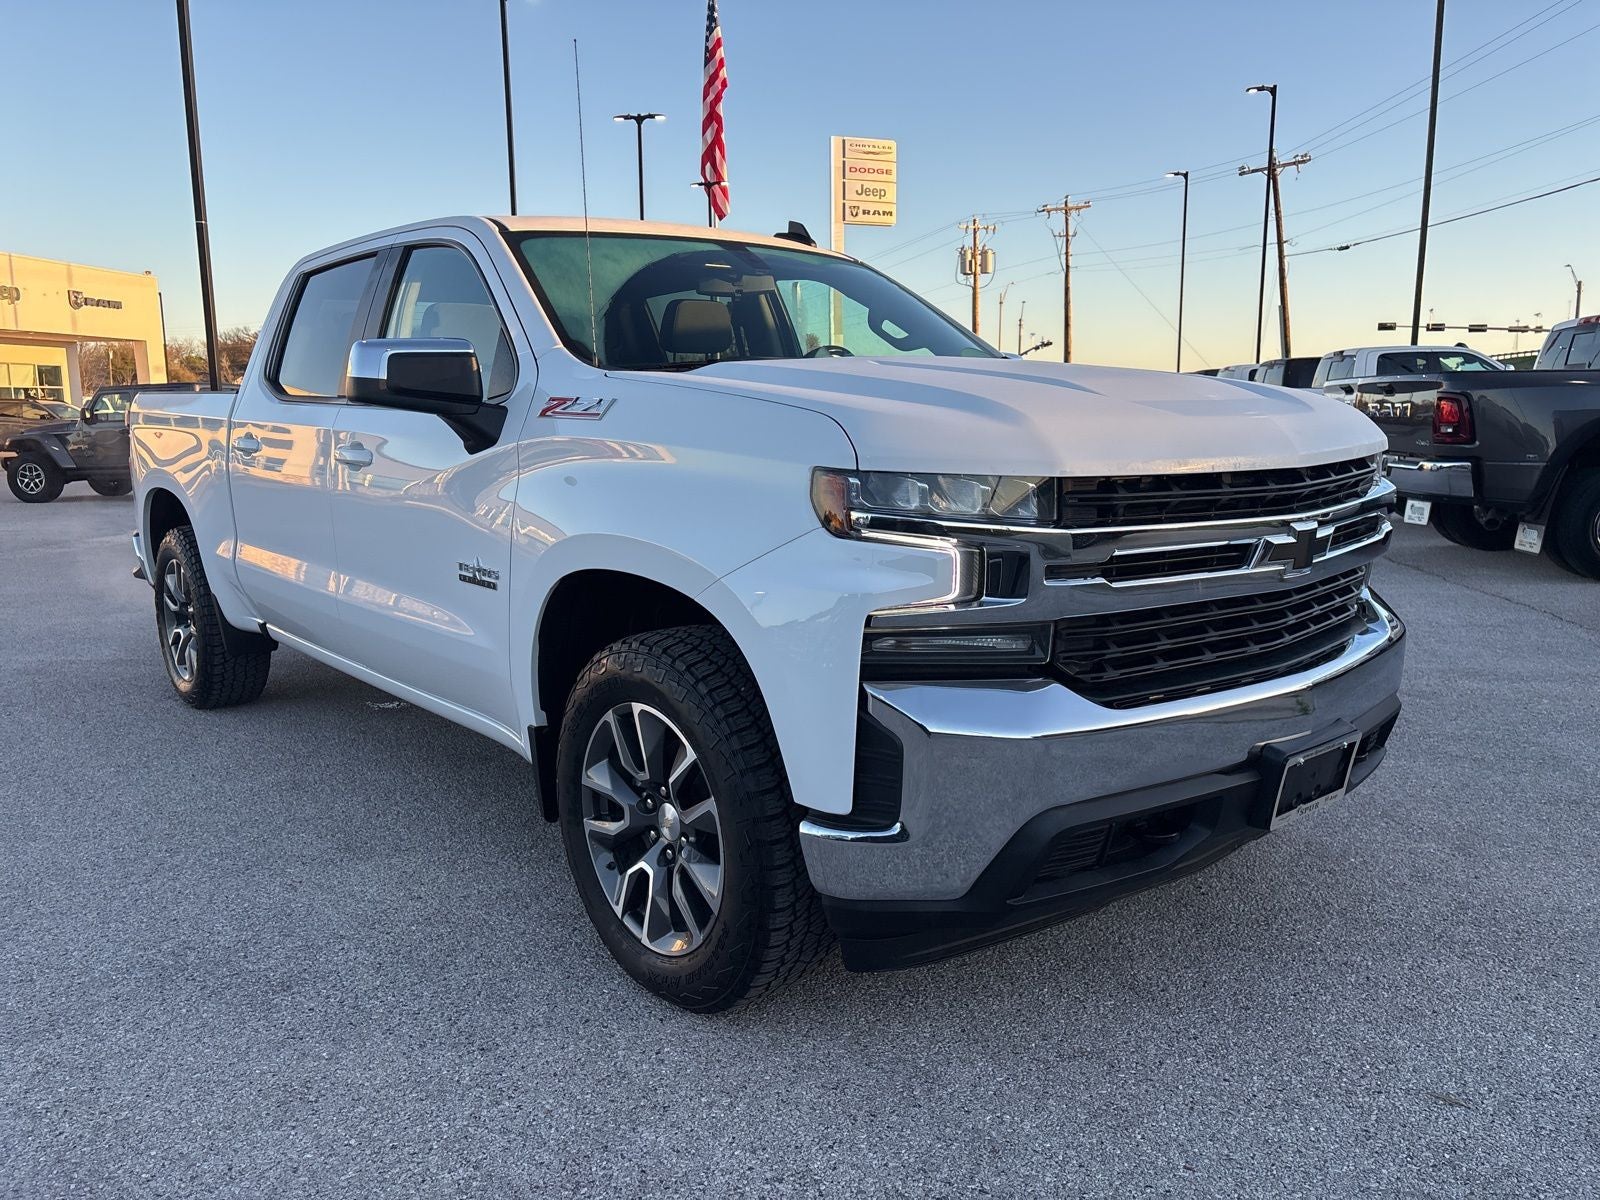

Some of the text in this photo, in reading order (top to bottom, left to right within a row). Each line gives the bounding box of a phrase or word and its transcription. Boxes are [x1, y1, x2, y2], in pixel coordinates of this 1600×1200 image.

[849, 142, 893, 150] CHRYSLER
[848, 166, 893, 175] DODGE
[855, 183, 887, 200] Jeep
[861, 209, 894, 217] RAM
[537, 396, 618, 421] Z71
[1367, 402, 1412, 418] RAM
